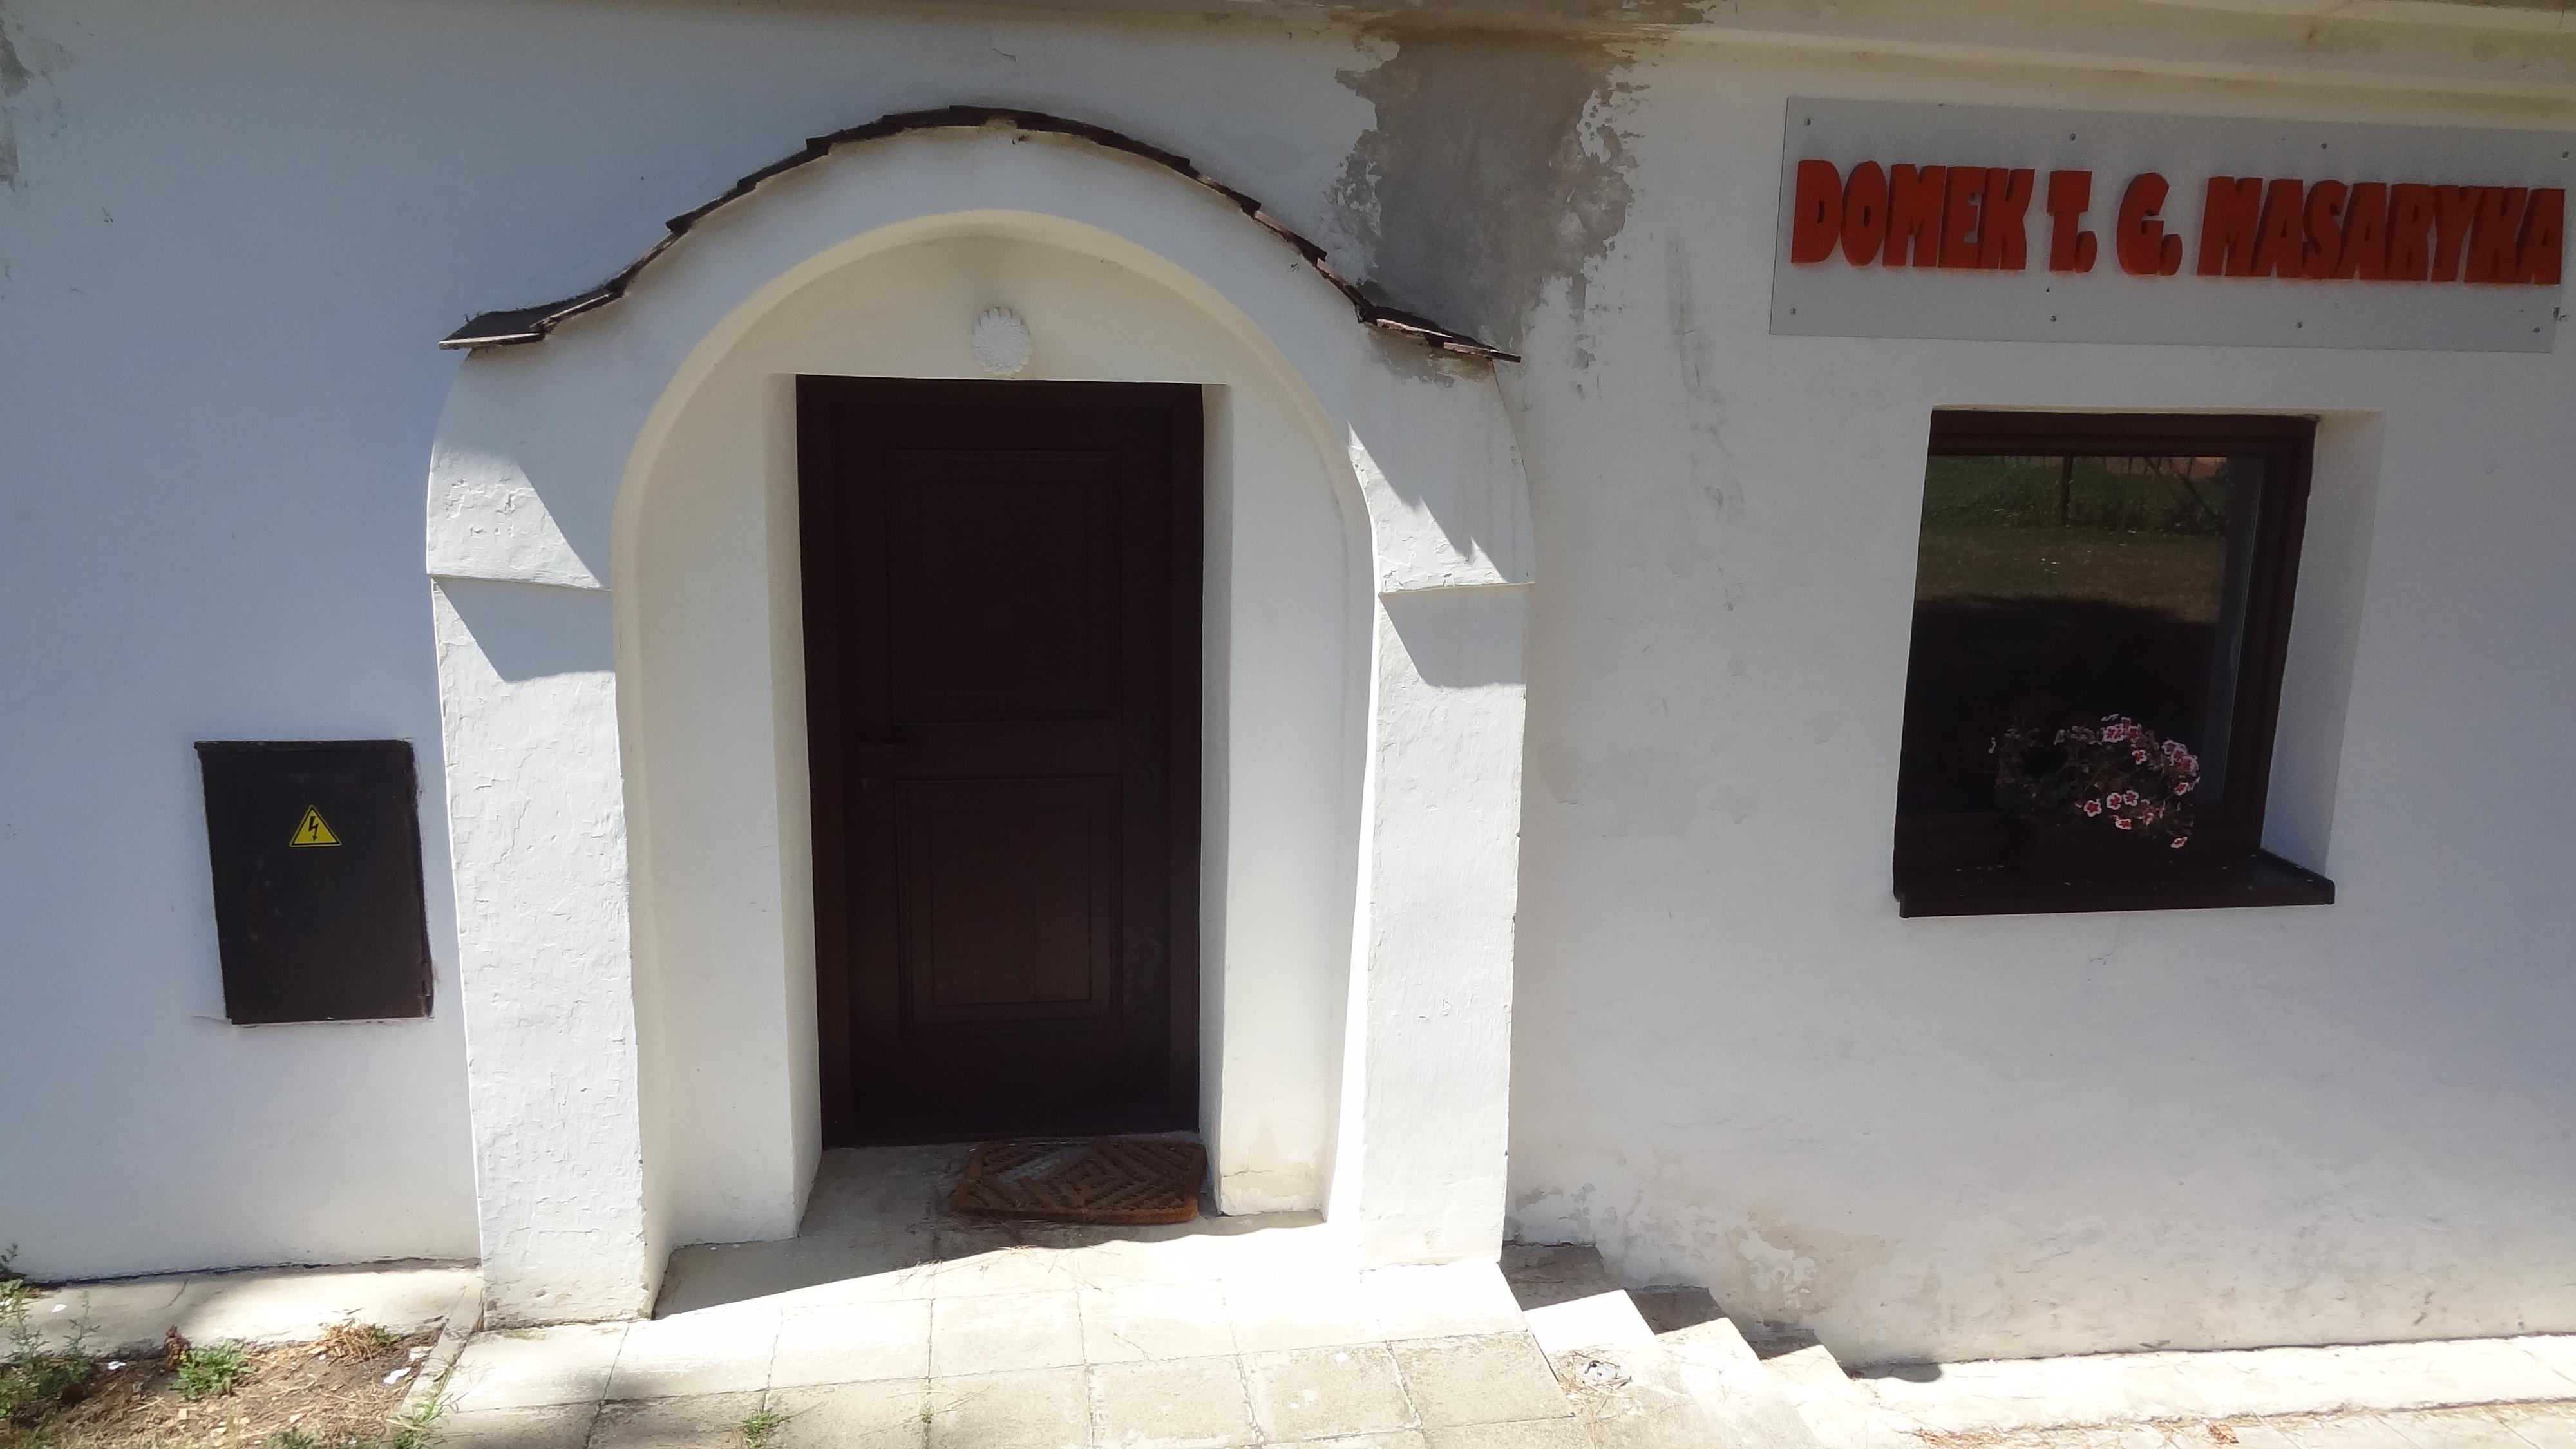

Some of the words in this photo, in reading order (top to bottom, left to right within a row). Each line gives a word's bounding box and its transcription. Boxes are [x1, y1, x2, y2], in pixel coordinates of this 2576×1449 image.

[1791, 160, 2035, 270] DOMEK
[2047, 170, 2098, 274] T.
[2116, 172, 2183, 276] G.
[2197, 176, 2566, 285] MASARYKA
